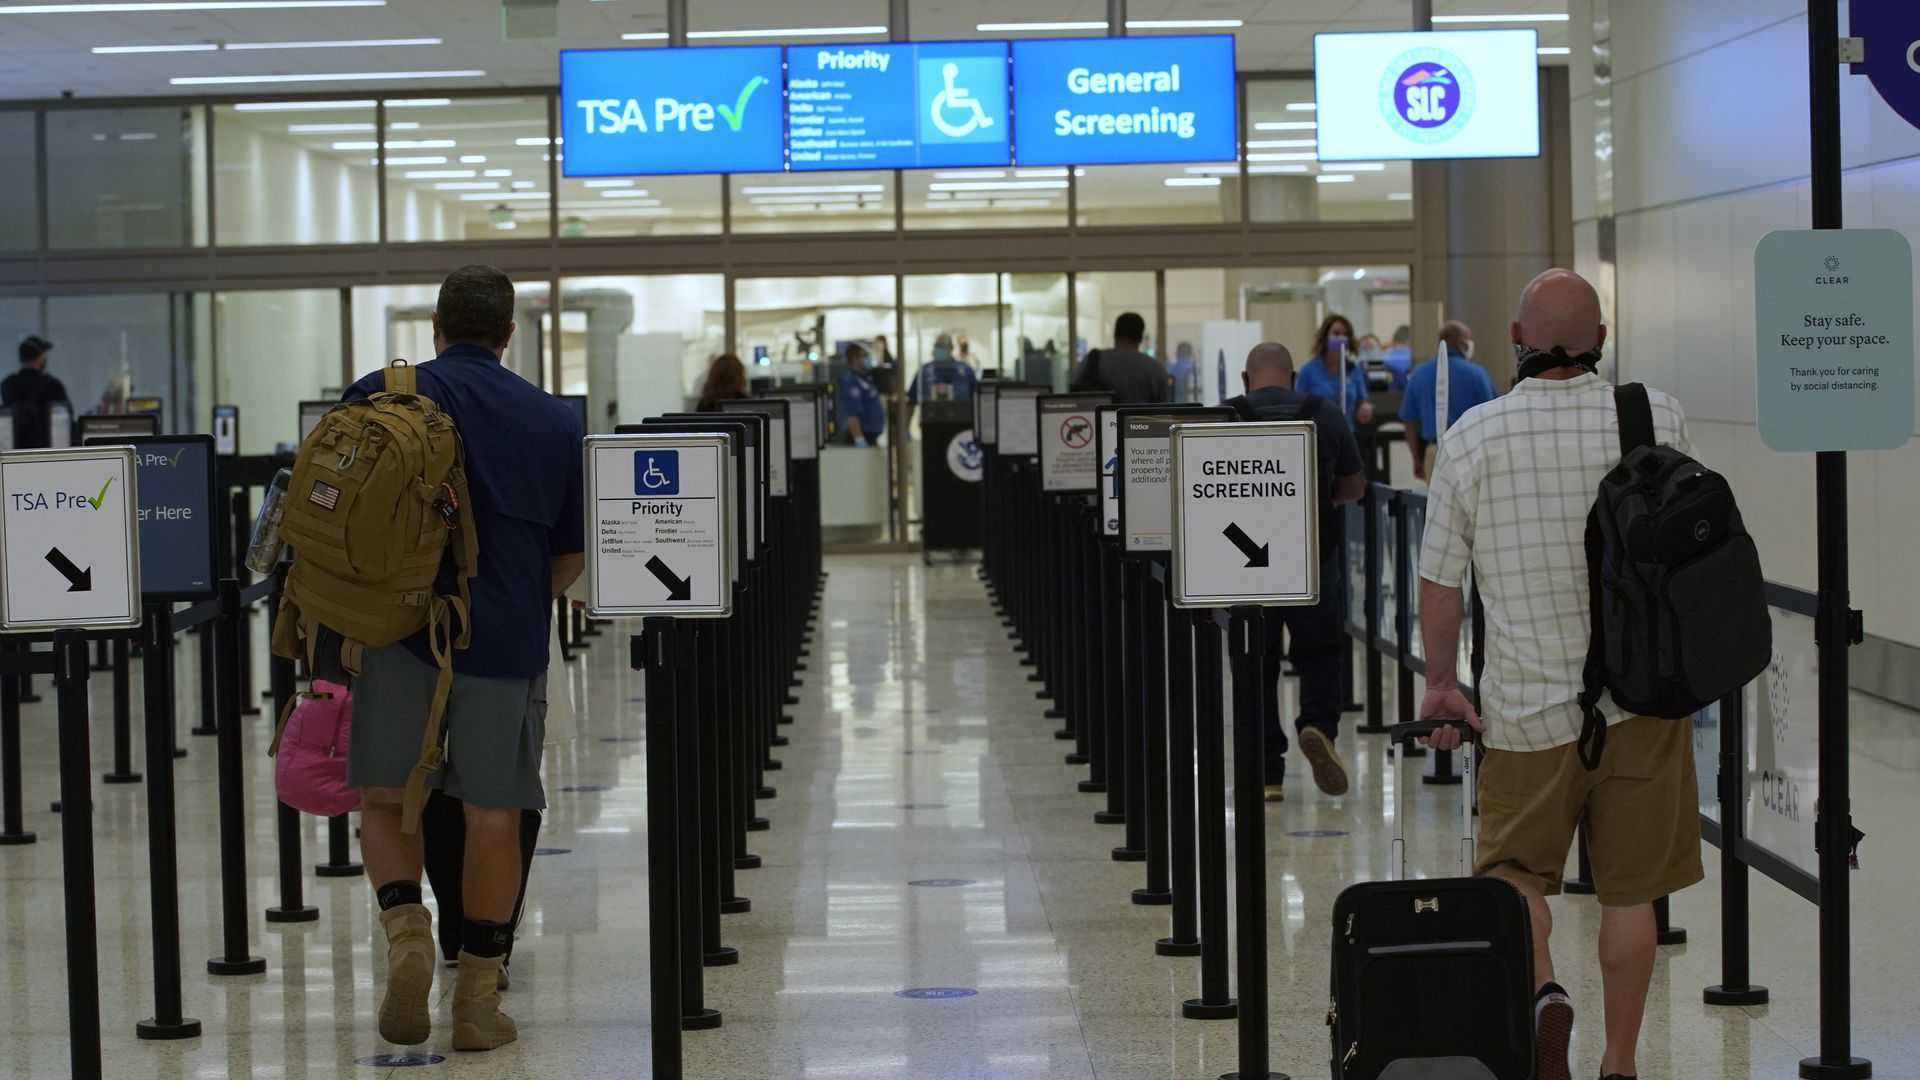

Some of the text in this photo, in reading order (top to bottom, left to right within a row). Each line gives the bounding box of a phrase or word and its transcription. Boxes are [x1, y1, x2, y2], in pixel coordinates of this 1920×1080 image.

[817, 49, 891, 72] Priority
[1067, 63, 1180, 95] General
[1405, 85, 1446, 122] SLC
[576, 97, 715, 134] TSA Pre
[1054, 106, 1196, 139] Screening
[1815, 276, 1849, 285] CLEAR
[1804, 312, 1865, 330] Stay safe.
[1780, 334, 1890, 350] Keep your space.
[1790, 366, 1880, 379] Thank you for caring
[1790, 380, 1879, 393] by social distancing.
[146, 453, 168, 467] Pre
[1131, 457, 1154, 465] where
[1202, 459, 1286, 476] GENERAL
[1131, 467, 1162, 475] property
[1131, 476, 1167, 484] additional
[1192, 481, 1296, 499] SCREENING
[11, 491, 87, 511] TSA Pre
[632, 501, 683, 517] Priority
[155, 505, 192, 520] Here
[1761, 769, 1800, 824] CLEAR
